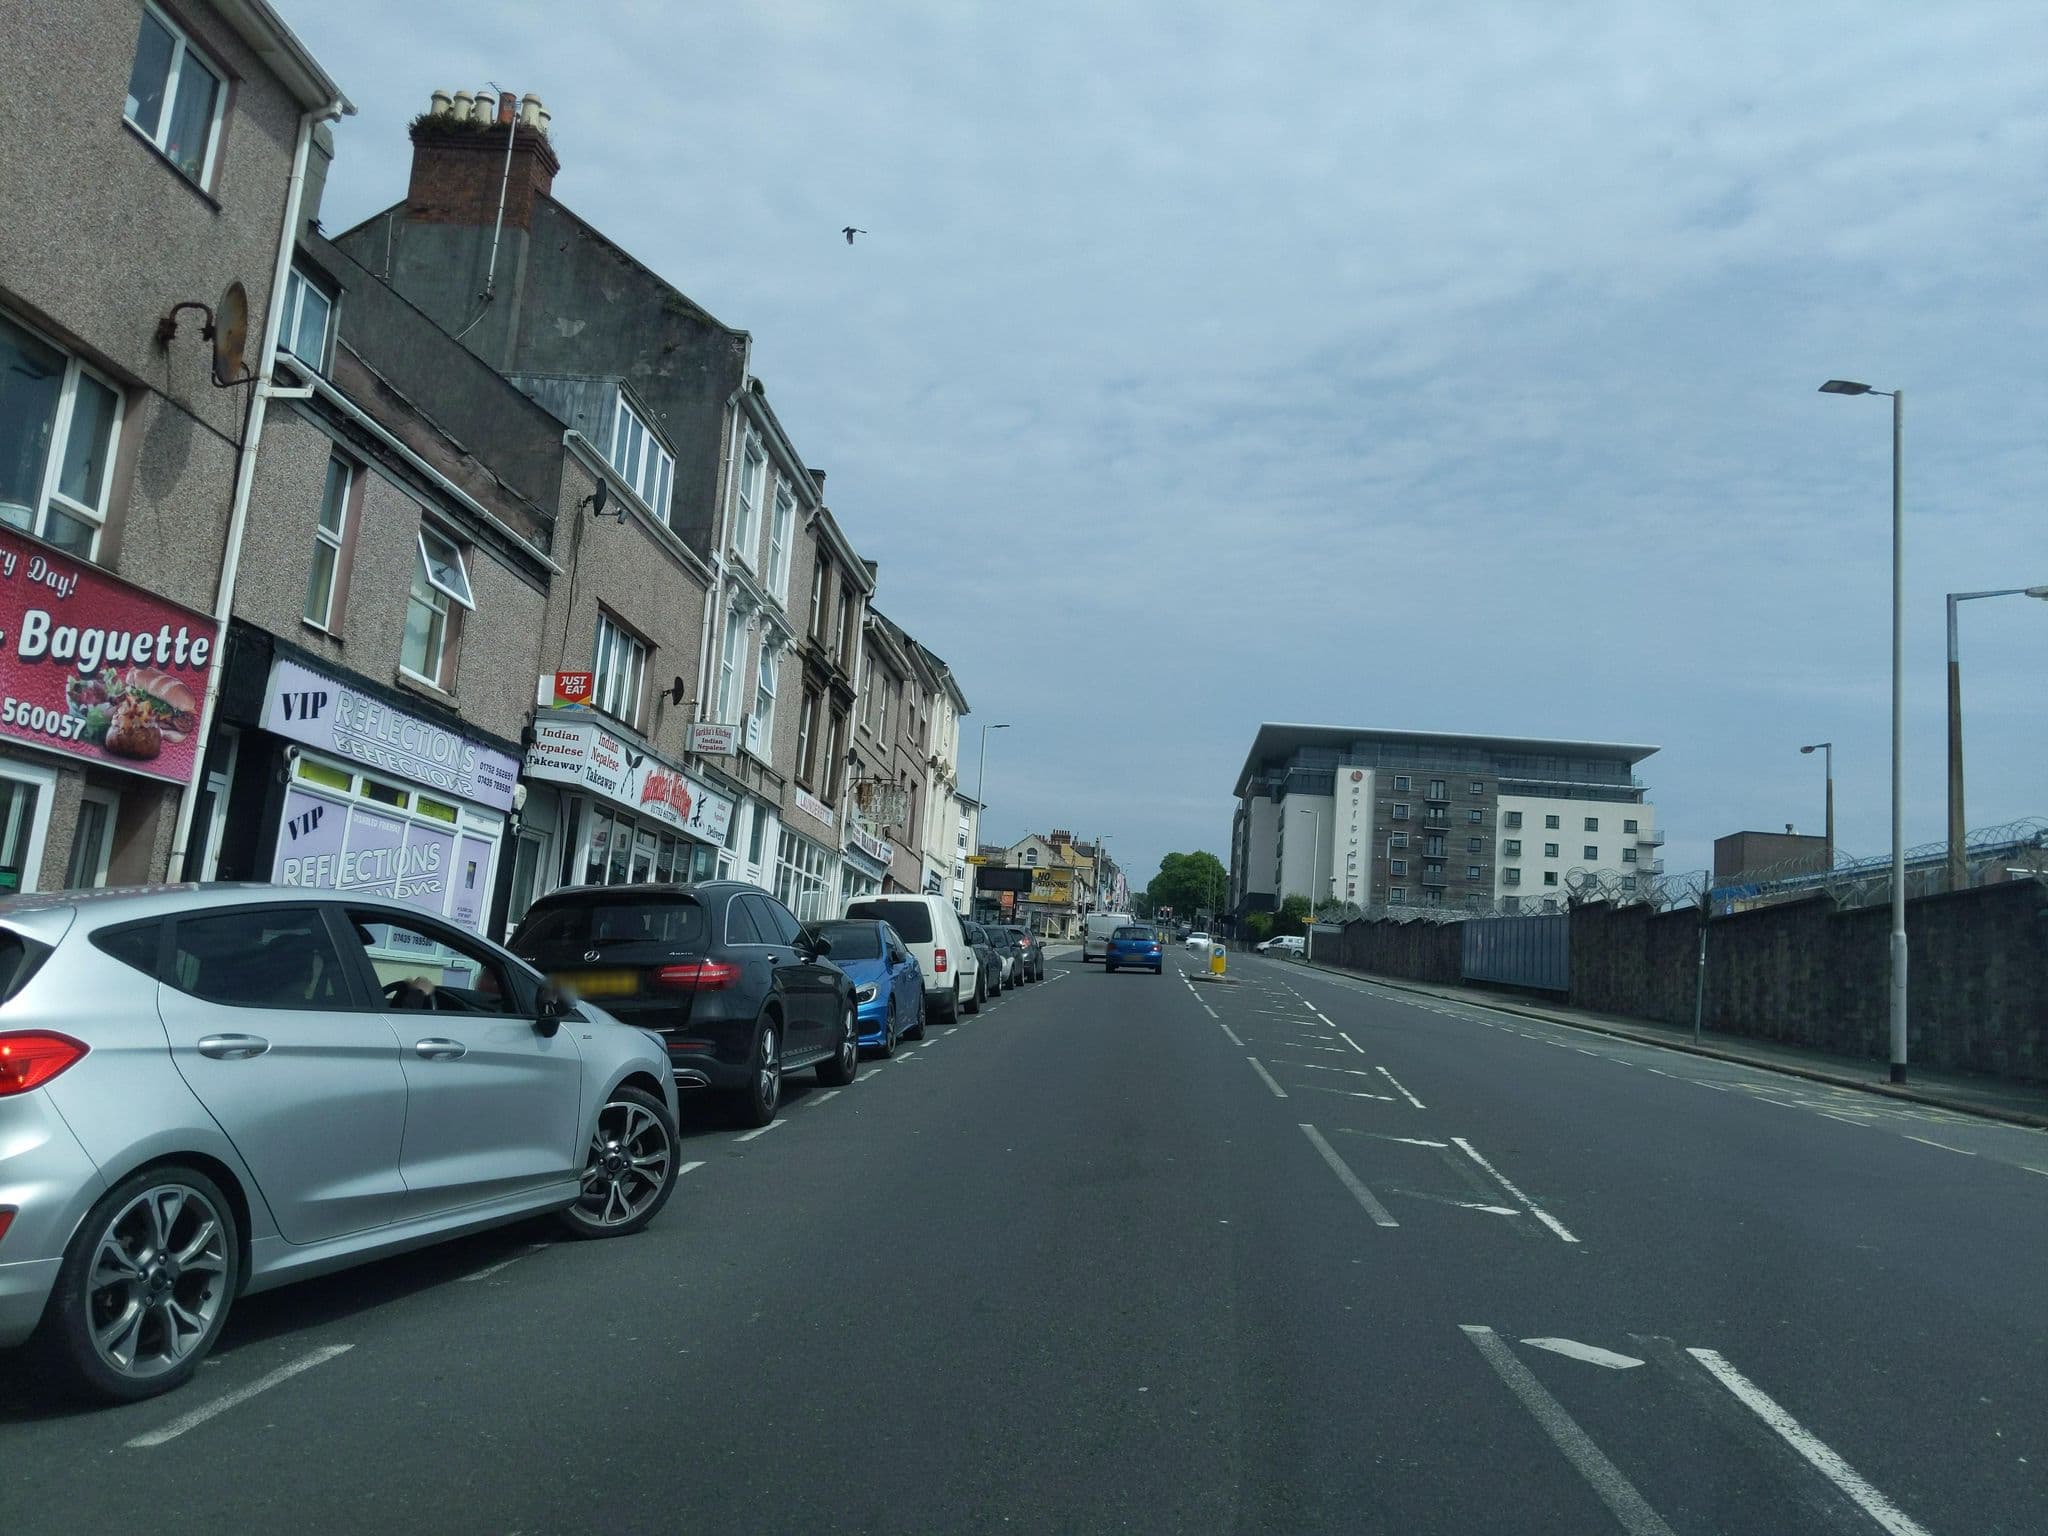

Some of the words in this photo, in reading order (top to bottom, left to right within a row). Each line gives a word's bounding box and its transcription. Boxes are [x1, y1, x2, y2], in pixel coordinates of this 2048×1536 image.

[27, 556, 78, 598] Day!
[18, 610, 209, 673] Baguette
[560, 676, 587, 686] JUST
[565, 685, 586, 694] EAT
[2, 697, 86, 740] 560057
[281, 692, 327, 720] VIP
[335, 690, 476, 773] REFLECTIONS
[543, 727, 580, 741] Indian
[598, 732, 618, 754] Indian
[531, 741, 583, 757] Nepalese
[591, 746, 619, 771] Nepalese
[528, 755, 582, 773] Takeaway
[586, 767, 617, 794] Takeaway
[288, 806, 324, 840] VIP
[283, 842, 440, 888] REFLECTIONS
